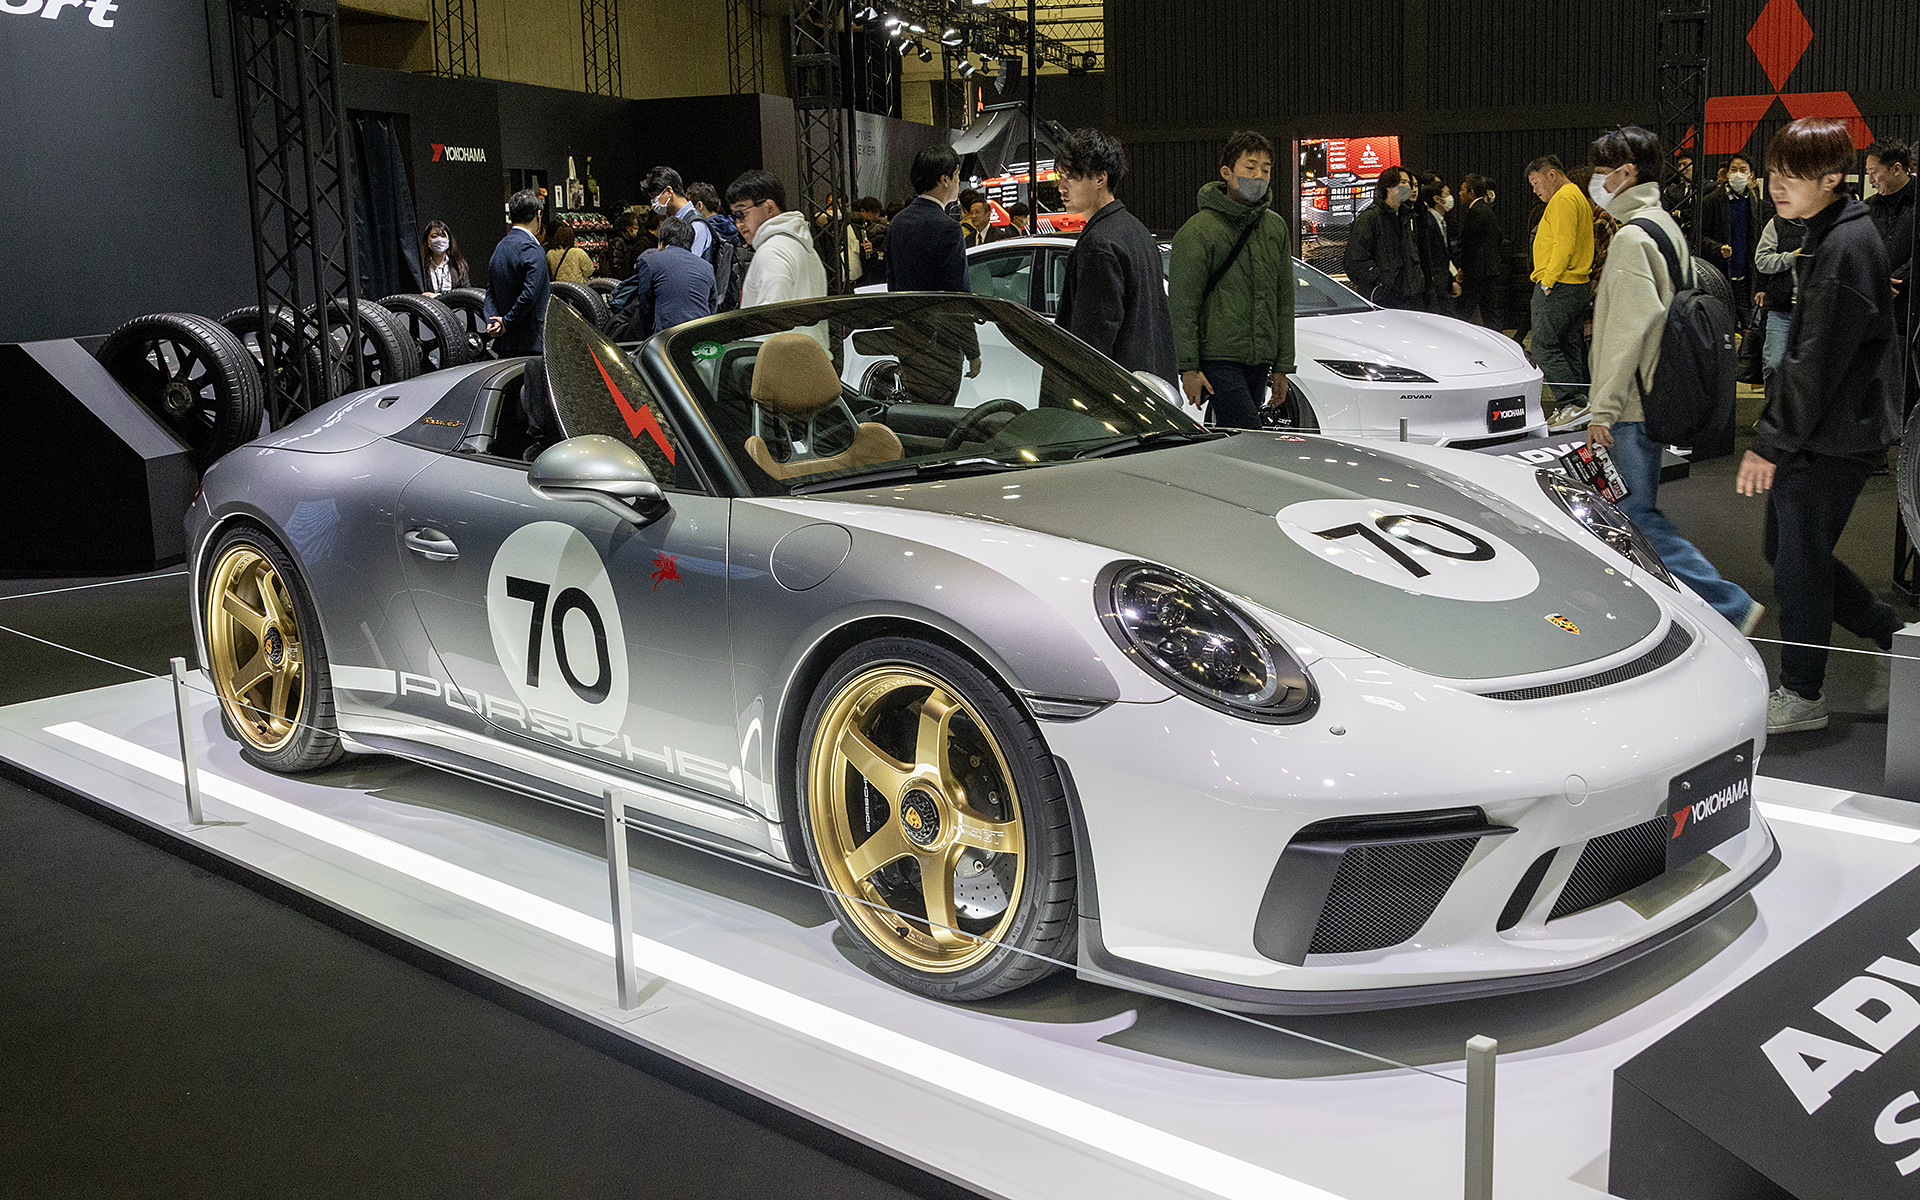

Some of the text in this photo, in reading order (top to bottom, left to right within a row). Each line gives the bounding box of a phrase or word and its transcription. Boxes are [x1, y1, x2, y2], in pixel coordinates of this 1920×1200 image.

[444, 146, 487, 162] YOKOHAMA
[1500, 408, 1525, 419] YOKOHAMA
[1311, 514, 1497, 579] 70
[506, 575, 613, 705] 70
[400, 670, 733, 792] PORSCHE
[1691, 777, 1749, 825] YOKOHAMA
